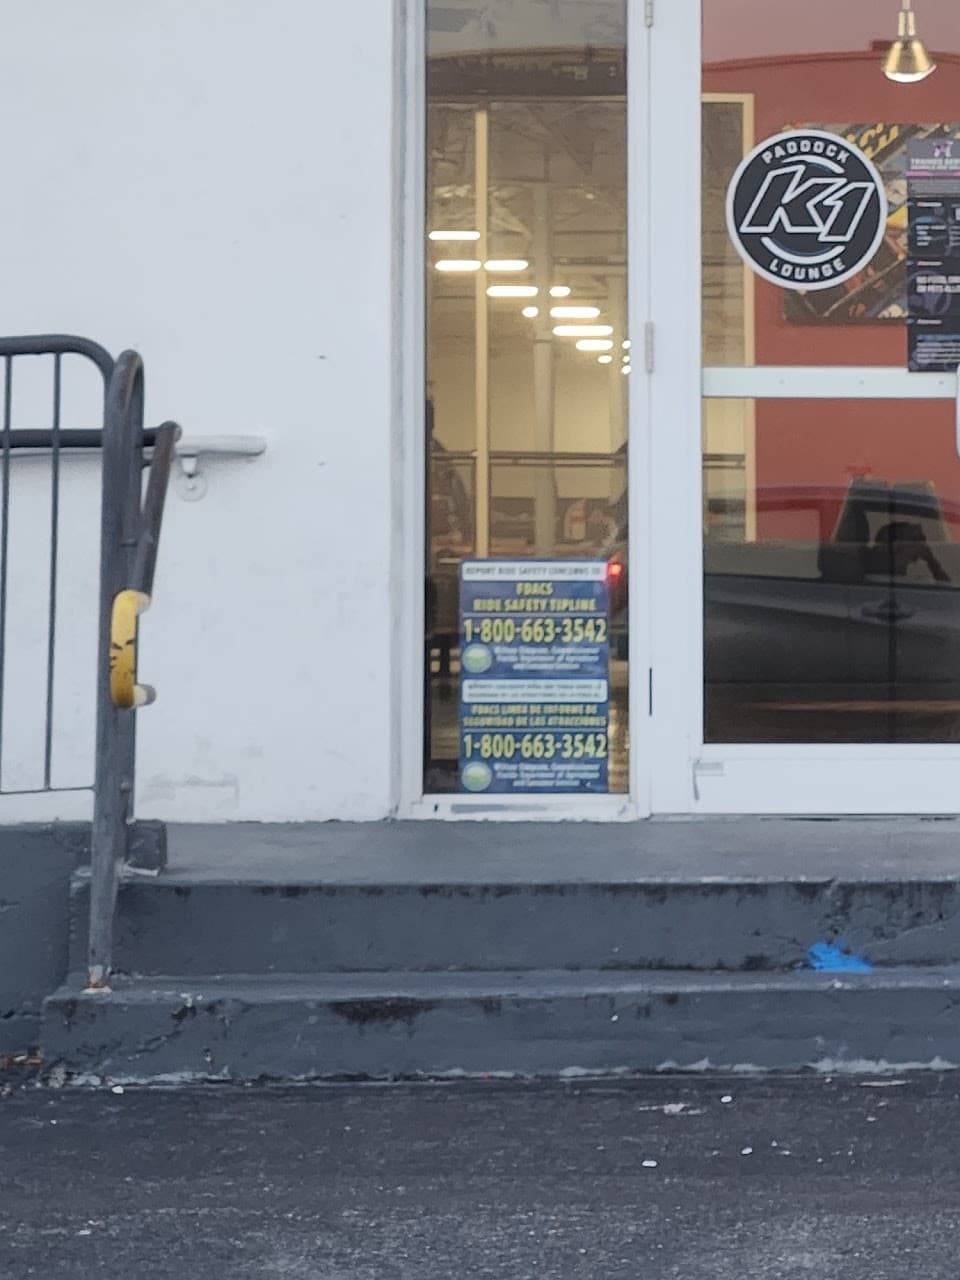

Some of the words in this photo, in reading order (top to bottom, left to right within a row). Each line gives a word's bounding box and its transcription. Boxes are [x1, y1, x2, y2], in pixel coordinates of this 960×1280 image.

[761, 139, 850, 164] PADDOCK
[739, 164, 876, 242] K1
[769, 258, 846, 280] LOUNGE
[504, 598, 547, 611] SAFETY
[464, 618, 607, 642] 1-800-663-3542
[464, 734, 607, 758] 1-800-663-3542
